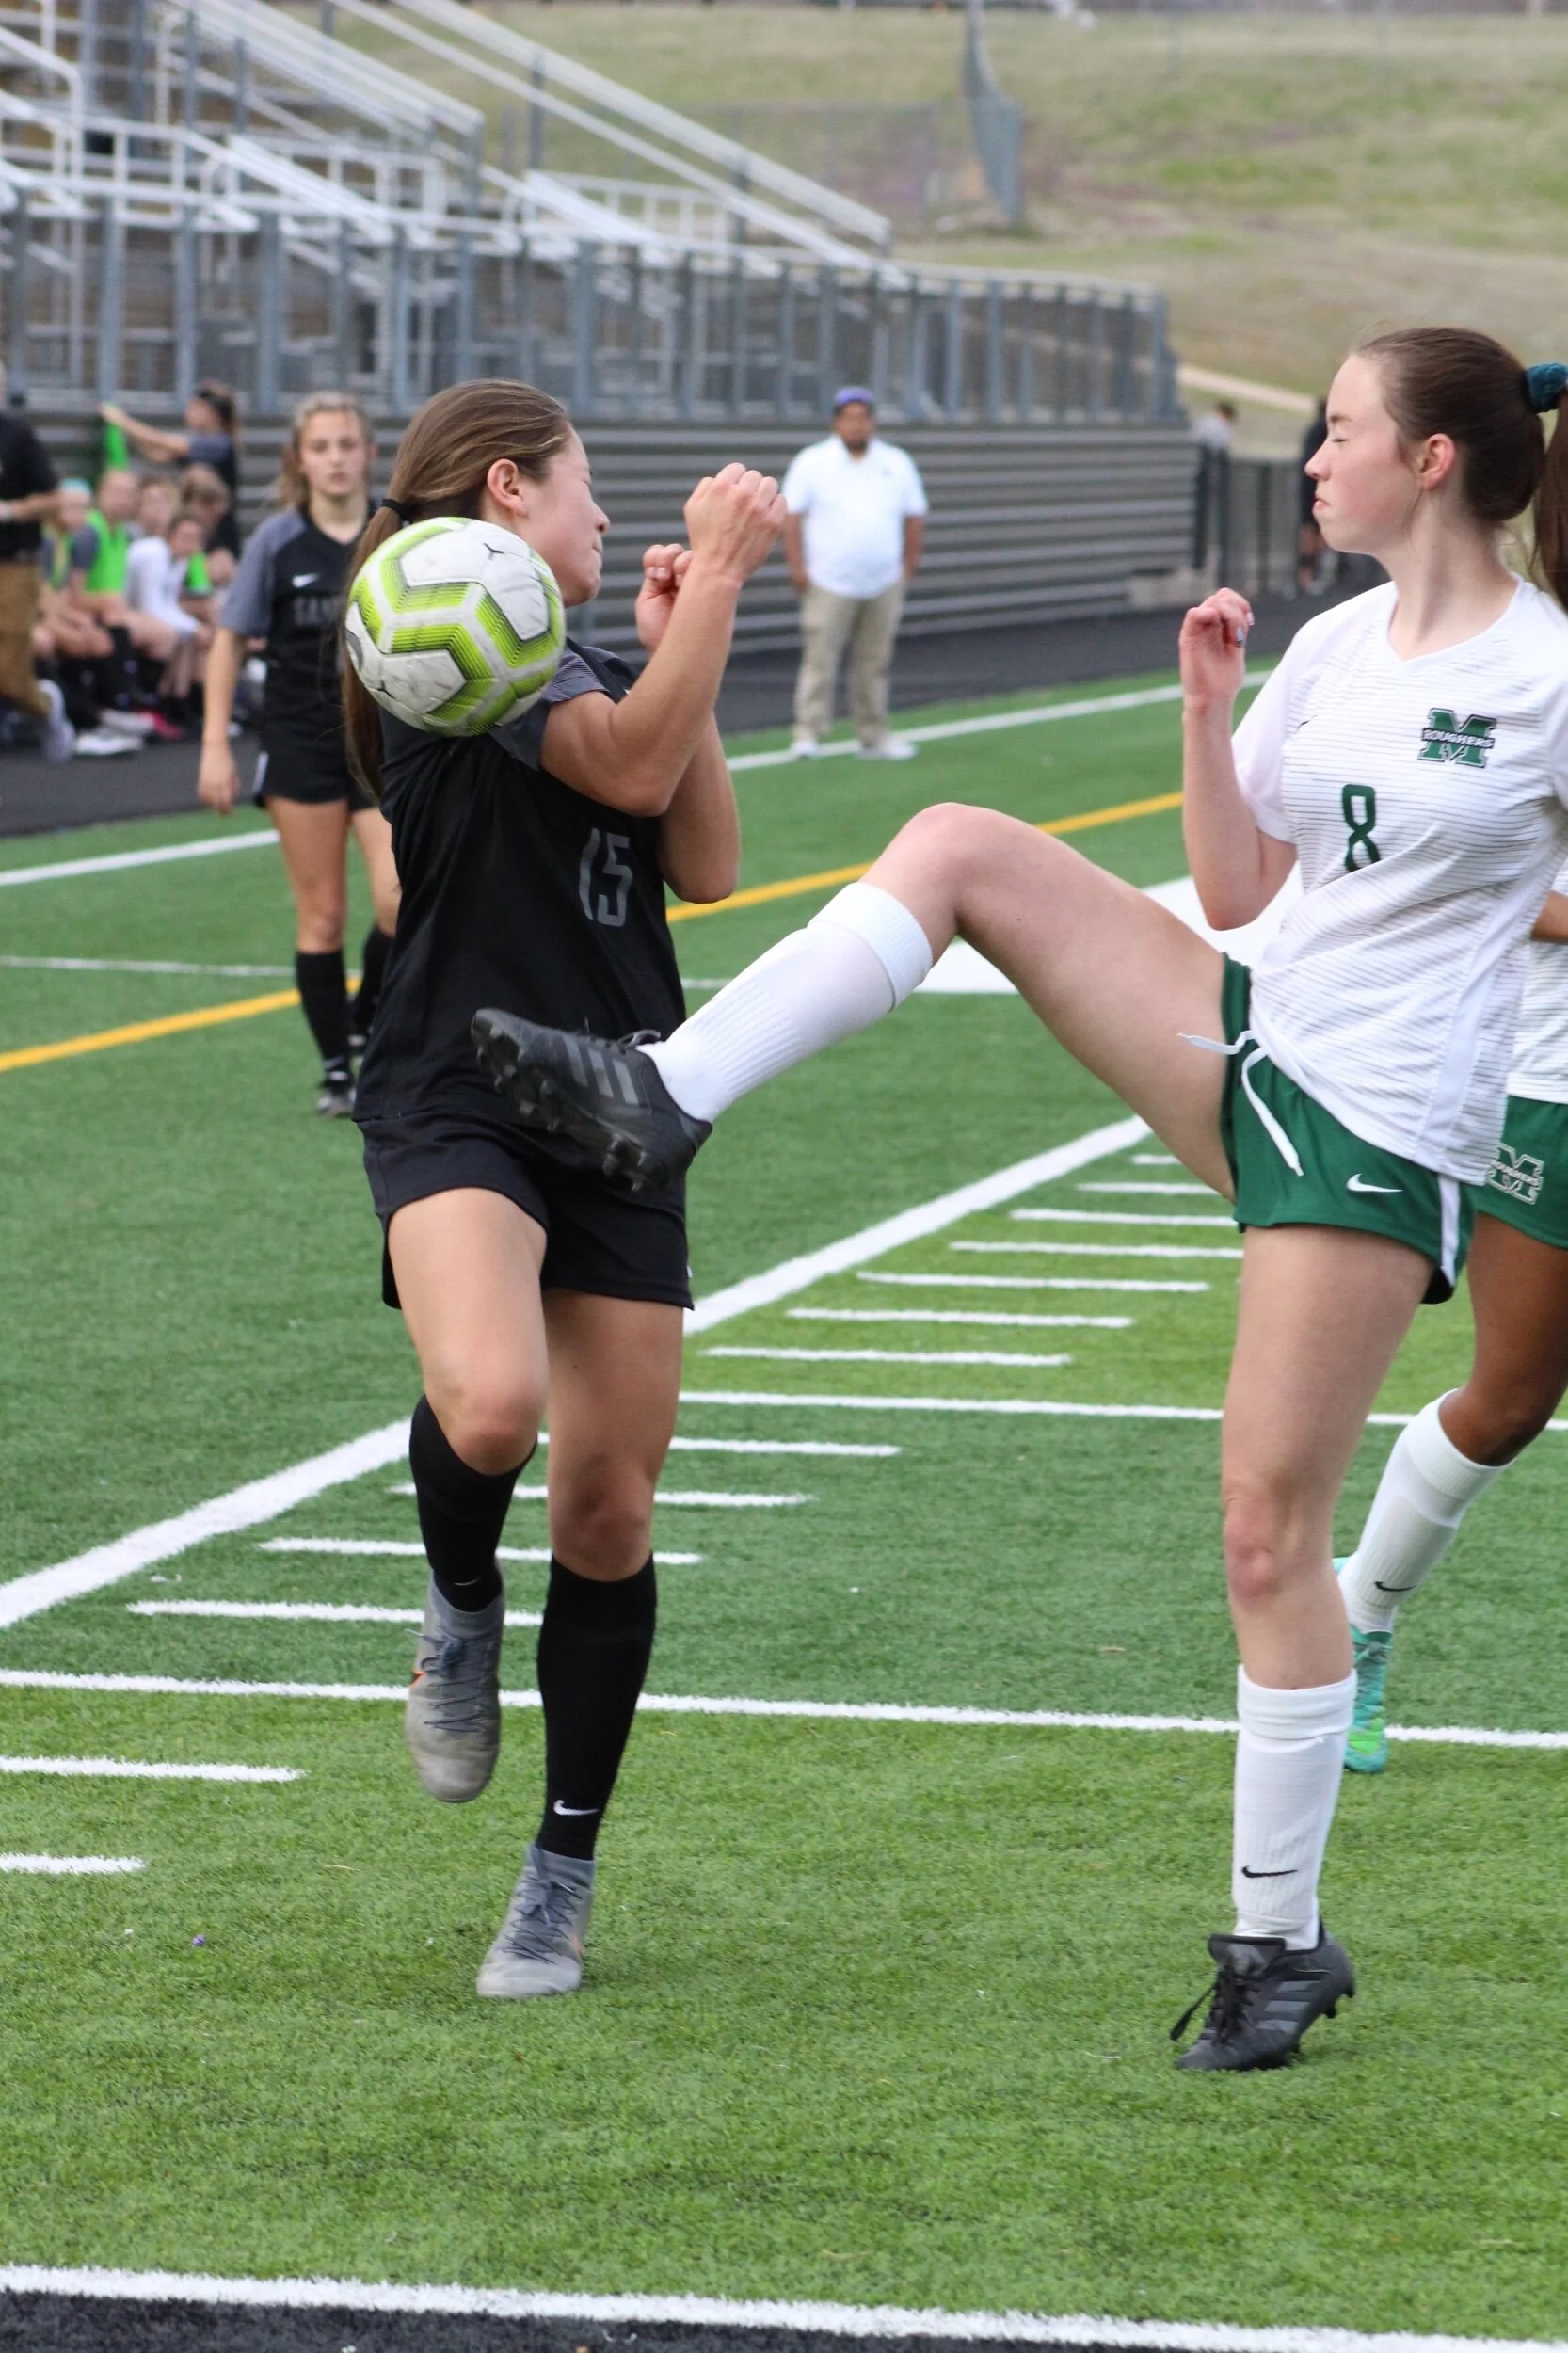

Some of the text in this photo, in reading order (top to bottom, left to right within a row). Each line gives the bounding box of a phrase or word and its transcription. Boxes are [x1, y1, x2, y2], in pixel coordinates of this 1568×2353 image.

[1417, 708, 1497, 768] M
[1422, 728, 1495, 749] ROUGHERS
[1342, 784, 1381, 872] 8
[579, 827, 633, 928] 15
